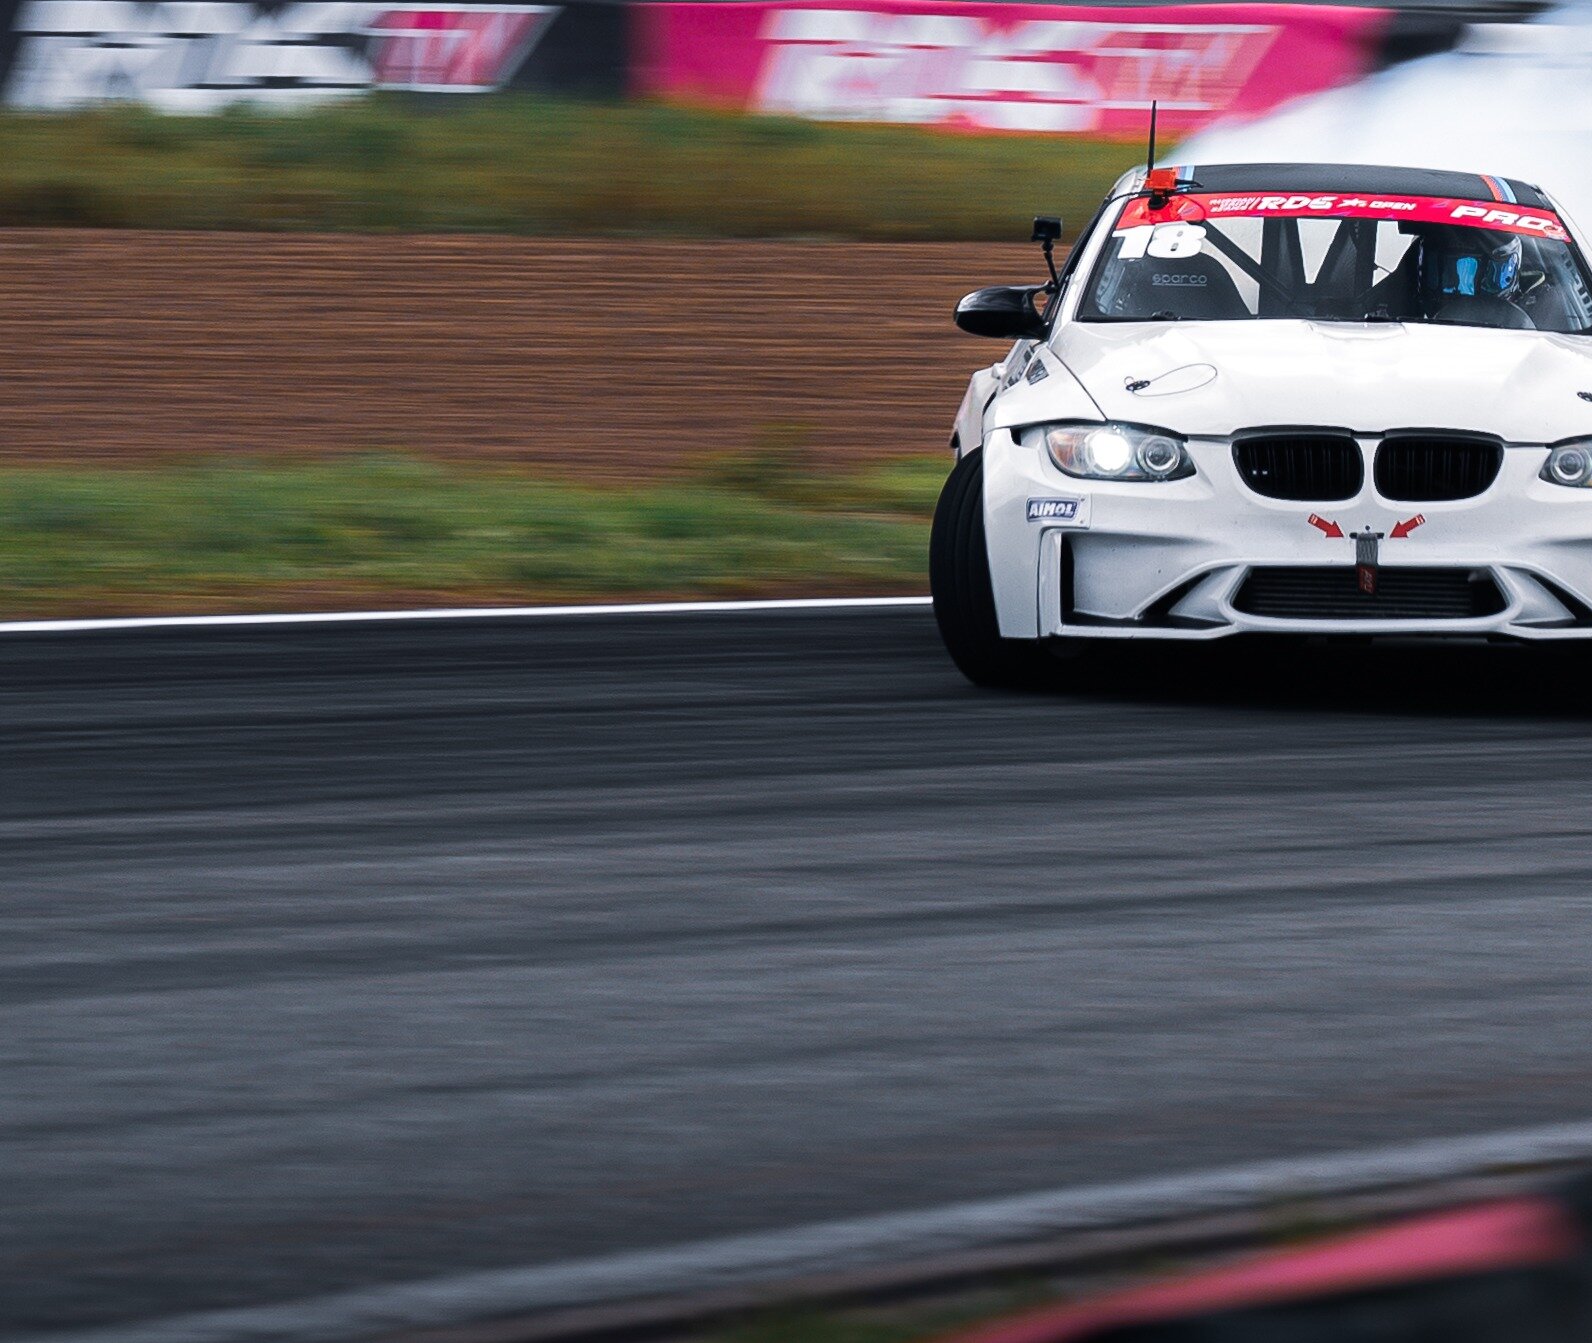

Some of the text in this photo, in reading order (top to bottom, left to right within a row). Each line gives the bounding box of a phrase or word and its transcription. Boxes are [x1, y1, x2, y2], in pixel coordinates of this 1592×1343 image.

[1257, 196, 1338, 210] RDS
[1450, 205, 1554, 231] PRO
[1112, 224, 1207, 259] 18
[1152, 272, 1208, 284] sparco
[1029, 502, 1076, 517] AIMOL
